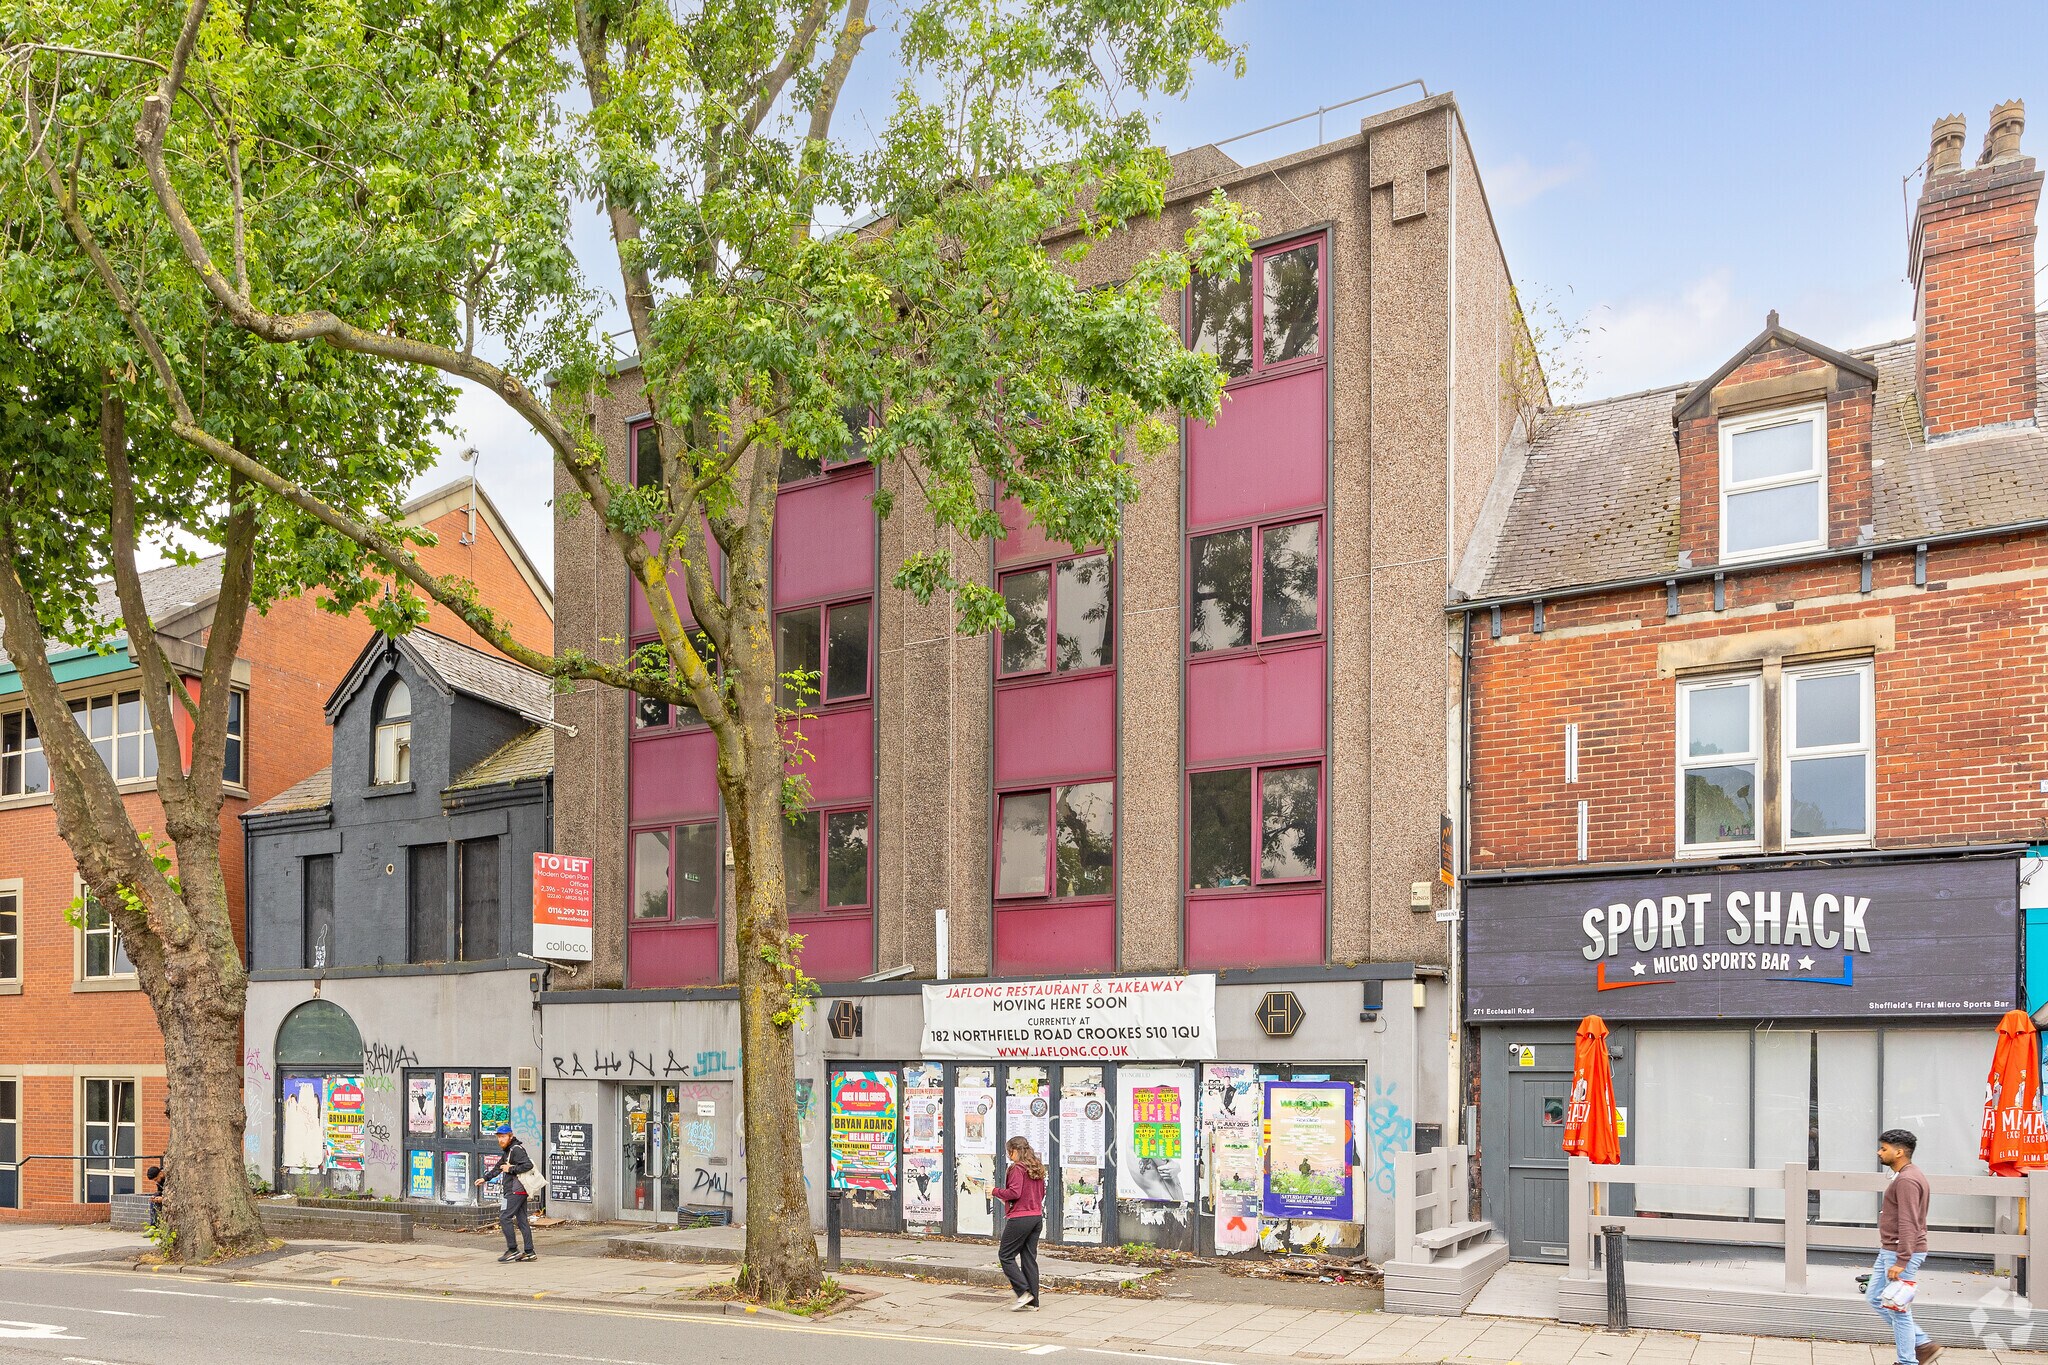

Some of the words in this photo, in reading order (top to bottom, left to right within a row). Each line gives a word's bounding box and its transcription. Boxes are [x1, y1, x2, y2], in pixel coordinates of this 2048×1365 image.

[538, 856, 560, 870] TO
[564, 859, 589, 873] LET
[537, 870, 559, 878] Modern
[563, 908, 575, 916] 299
[576, 909, 589, 917] 3121
[1582, 893, 1712, 961] SPORT
[1726, 890, 1871, 953] SHACK
[1653, 954, 1698, 975] MICRO
[1702, 952, 1756, 972] SPORTS
[1761, 953, 1790, 971] BAR
[946, 987, 1002, 999] JAFLONG
[1006, 984, 1088, 997] RESTAURANT
[1093, 983, 1103, 994] &
[1108, 980, 1184, 993] TAKEAWAY
[993, 999, 1046, 1012] MOVING
[1051, 998, 1082, 1010] HERE
[1086, 996, 1127, 1009] SOON
[1963, 1001, 1991, 1009] Sports
[1028, 1017, 1077, 1026] CURRENTLY
[1080, 1016, 1090, 1025] AT
[931, 1030, 950, 1042] 182
[953, 1029, 1029, 1042] NORTHFIELD
[1034, 1028, 1073, 1041] ROAD
[1077, 1027, 1141, 1040] CROOKES
[1146, 1026, 1168, 1039] S10
[1172, 1026, 1200, 1039] 1QU
[997, 1045, 1129, 1057] WWW.JAFLONG.CO.UK
[329, 1114, 346, 1123] BRYAN
[834, 1118, 862, 1129] BRYAN
[864, 1119, 893, 1130] ADAMS
[849, 1133, 875, 1141] MELANIE
[413, 1175, 433, 1188] SPEECH
